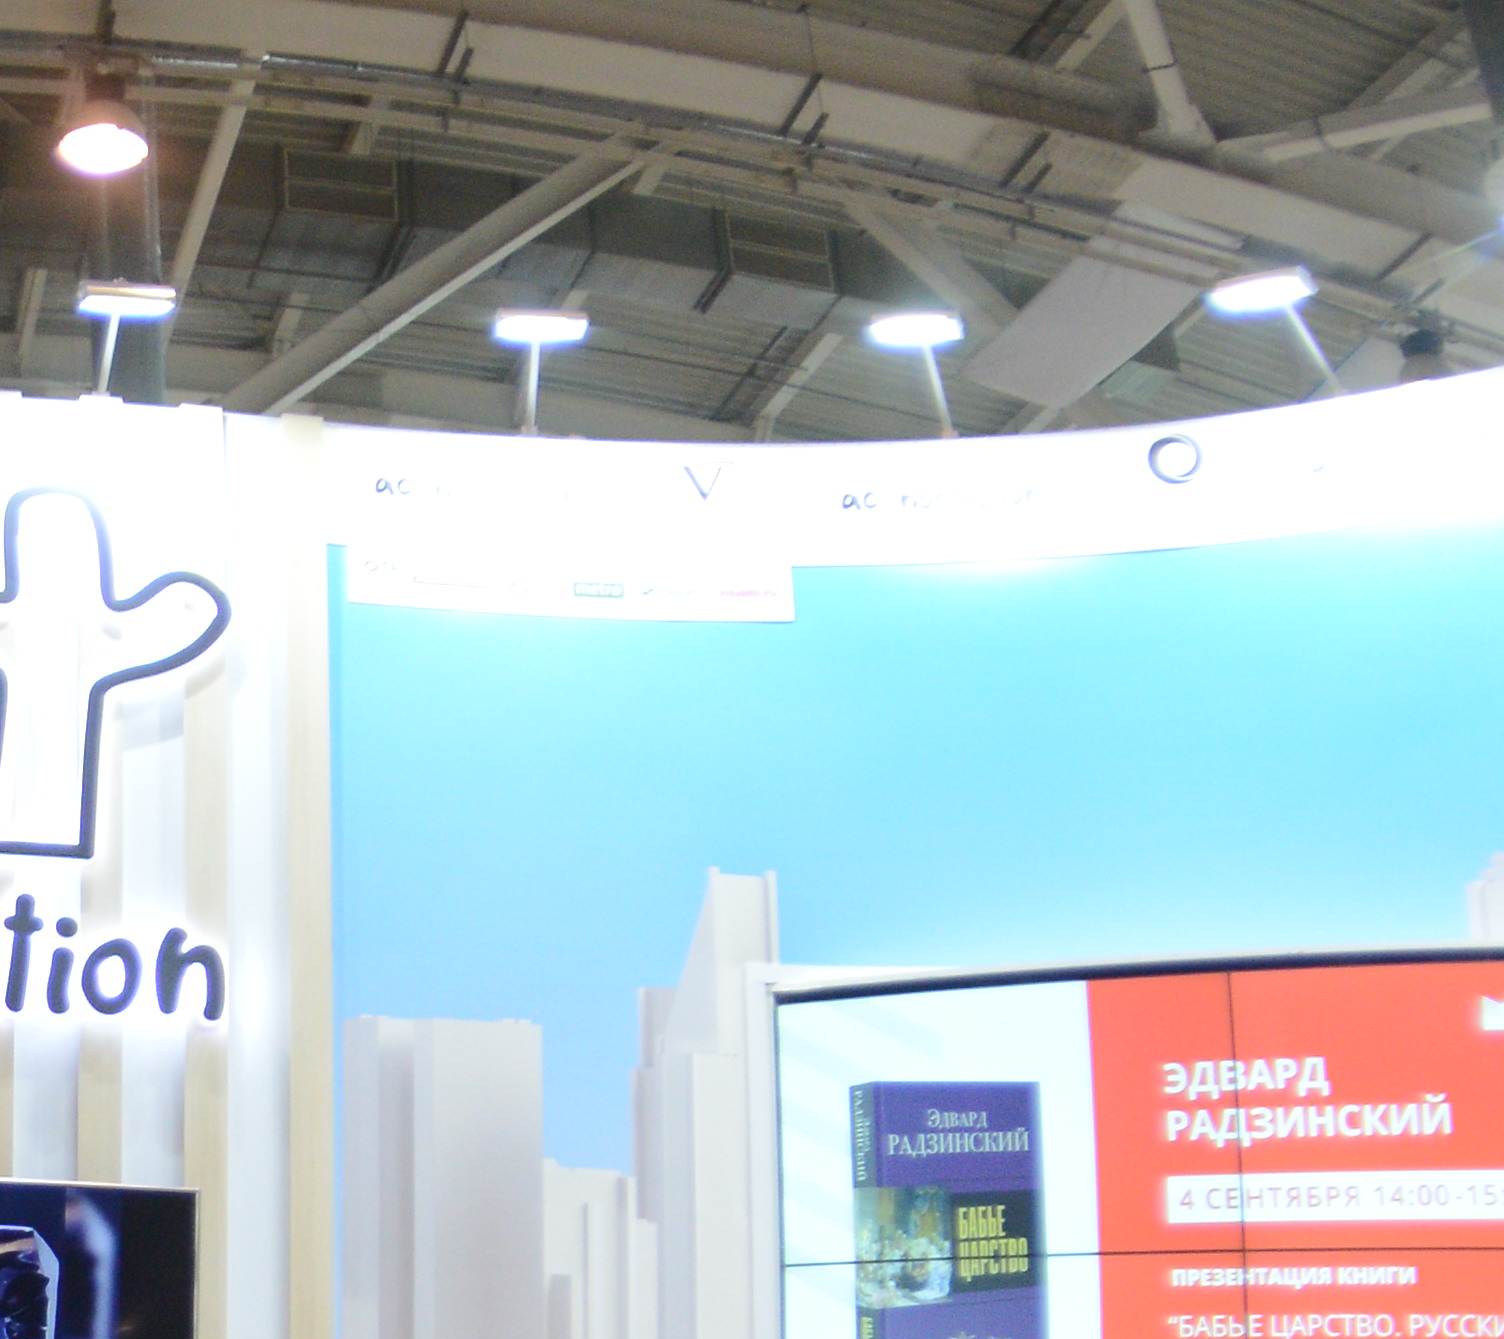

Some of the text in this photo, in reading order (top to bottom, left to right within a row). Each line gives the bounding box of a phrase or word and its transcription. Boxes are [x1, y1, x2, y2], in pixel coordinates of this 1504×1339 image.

[1162, 1056, 1332, 1100] ЭДВАРД
[1166, 1093, 1454, 1147] РАДЗИНСКИЙ
[888, 1128, 1030, 1158] РАДЗИНСКИЙ
[1179, 1188, 1195, 1210] 4
[1206, 1184, 1361, 1210] СЕНТЯБРЯ
[958, 1204, 1007, 1239] БАБЬЕ
[960, 1236, 1029, 1282] ЦАРСТВО
[1172, 1266, 1418, 1290] ПРЕЗЕНТАЦИЯ КНИГИ
